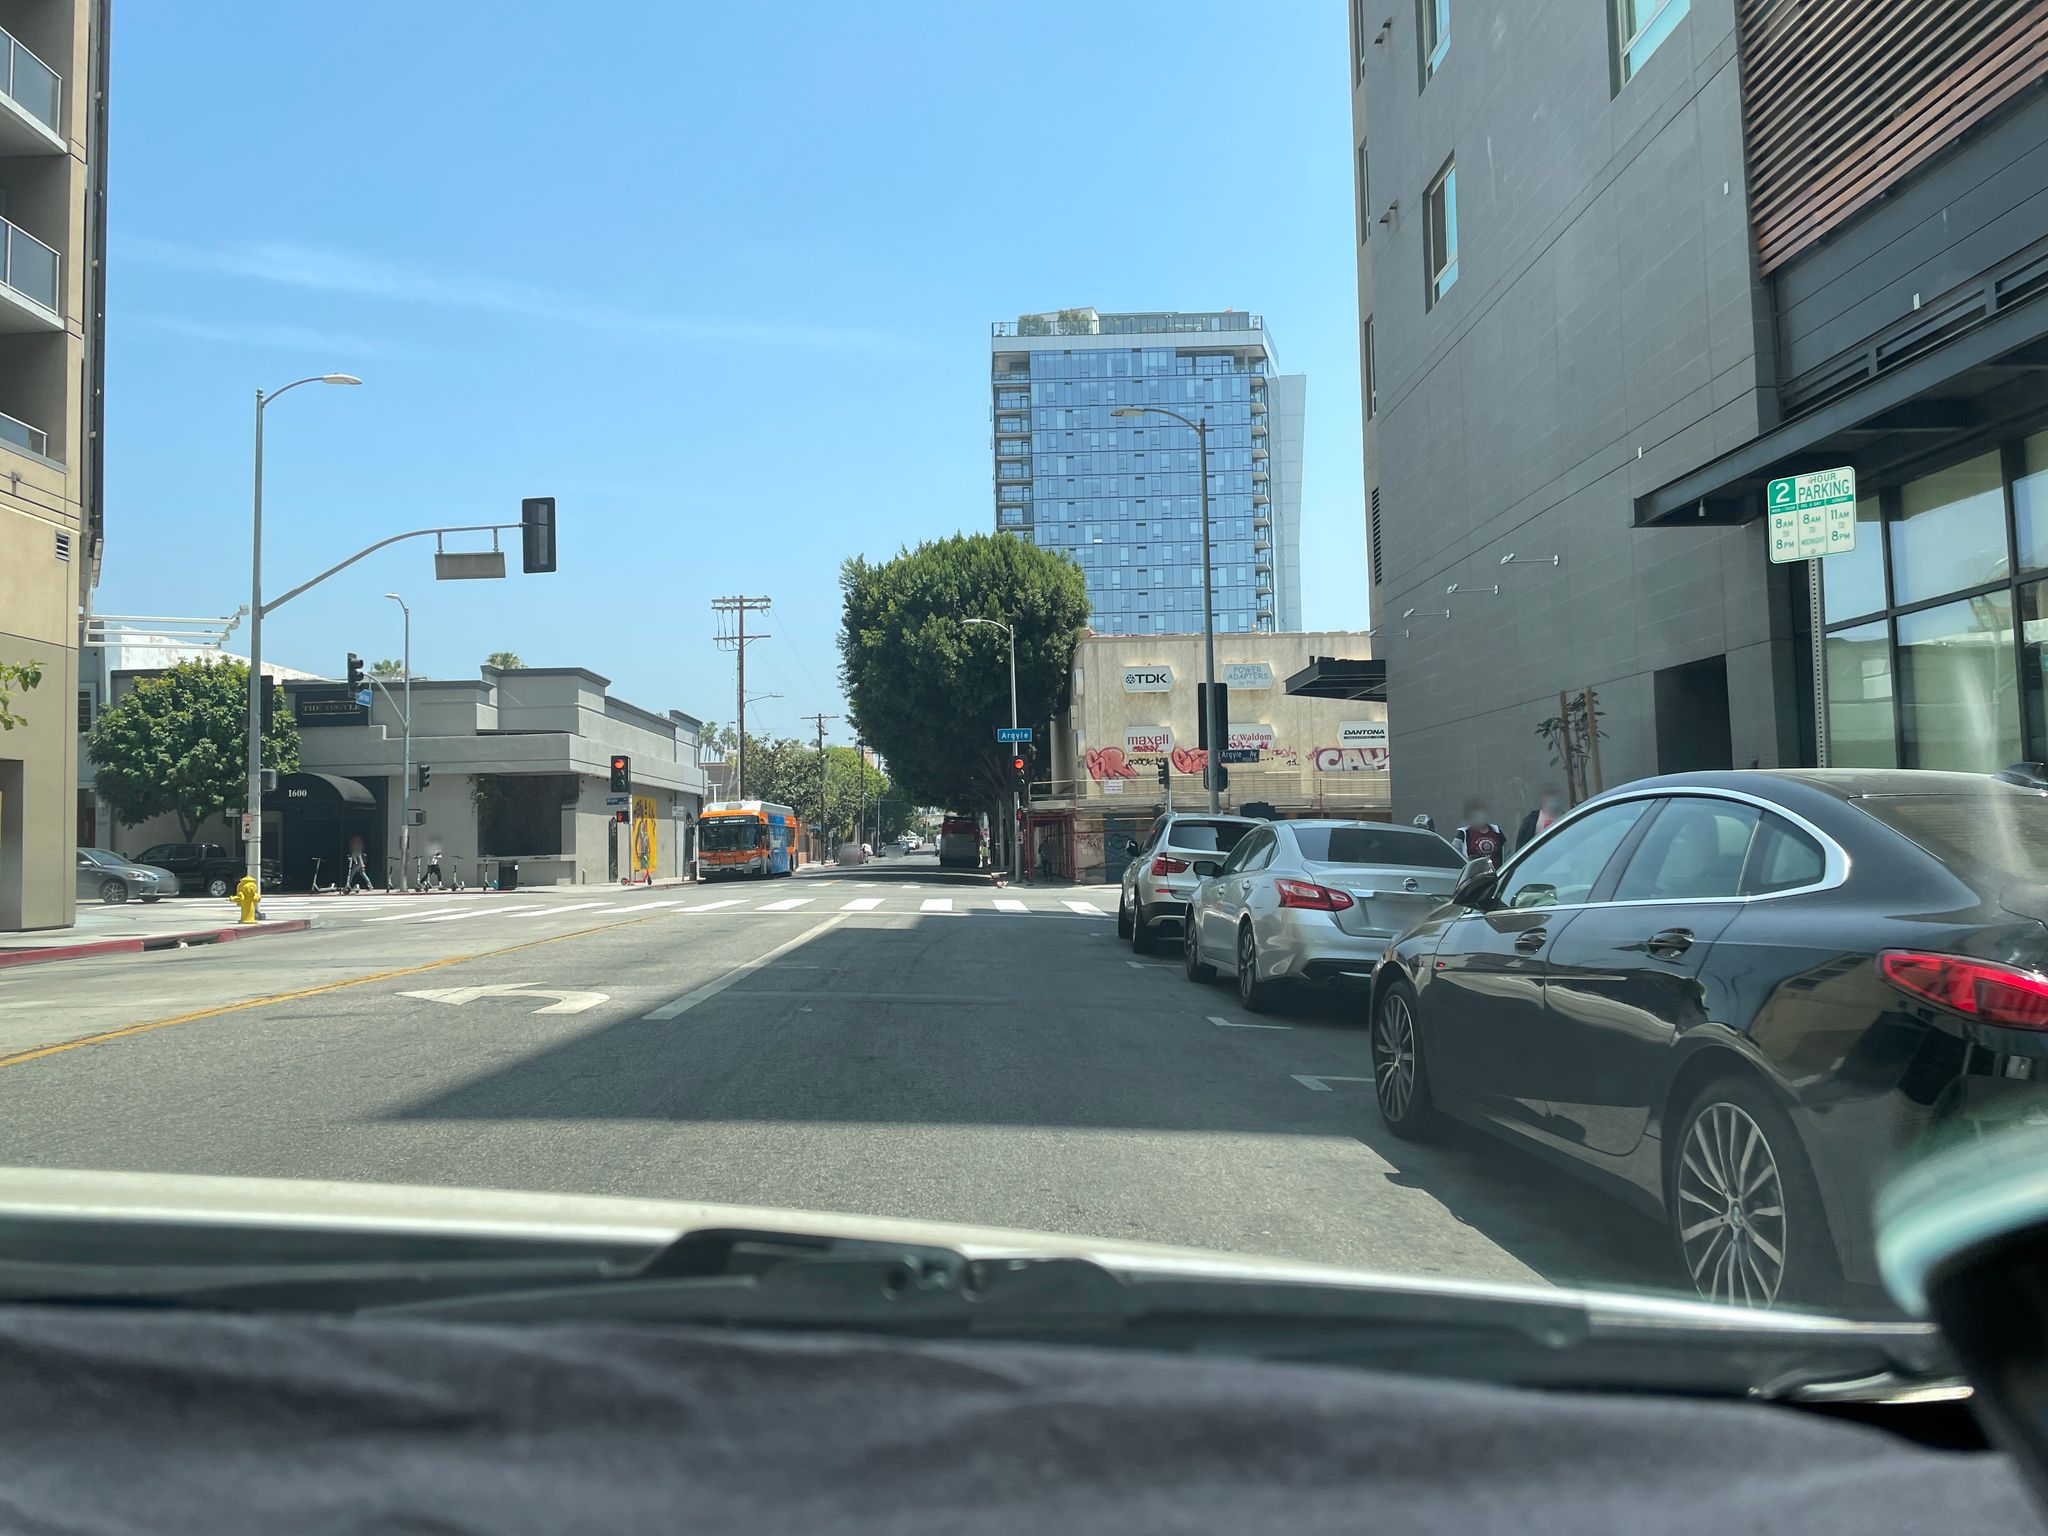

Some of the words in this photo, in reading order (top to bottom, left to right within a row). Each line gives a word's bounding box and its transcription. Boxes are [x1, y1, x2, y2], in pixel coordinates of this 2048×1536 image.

[1812, 472, 1836, 484] HOUR
[1775, 482, 1790, 503] 2
[1798, 479, 1850, 501] PARKING
[1233, 666, 1262, 674] POWER
[1134, 673, 1168, 684] TDK
[1228, 672, 1270, 680] ADAPTERS
[1001, 731, 1029, 740] Argyle
[1127, 734, 1169, 745] maxell
[1221, 749, 1242, 760] Argyle
[288, 789, 308, 798] 1600
